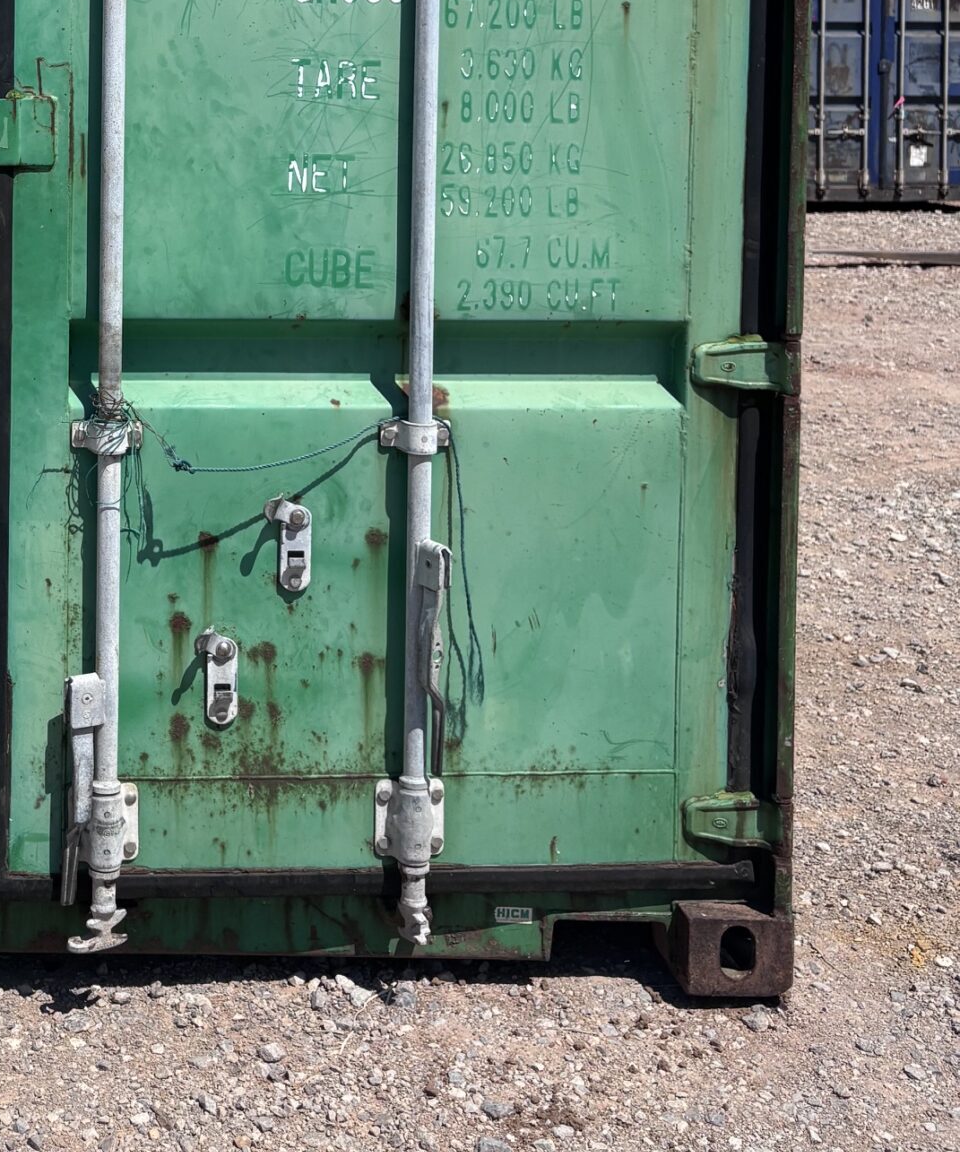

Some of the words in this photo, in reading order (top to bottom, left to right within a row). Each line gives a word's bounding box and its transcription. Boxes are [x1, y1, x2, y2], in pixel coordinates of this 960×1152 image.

[291, 58, 381, 99] TARE
[551, 48, 583, 81] KG
[550, 91, 581, 124] LB
[288, 152, 356, 193] NET
[549, 142, 580, 175] KG
[548, 186, 579, 217] LB
[284, 248, 376, 288] CUBE
[476, 236, 532, 269] 67.7
